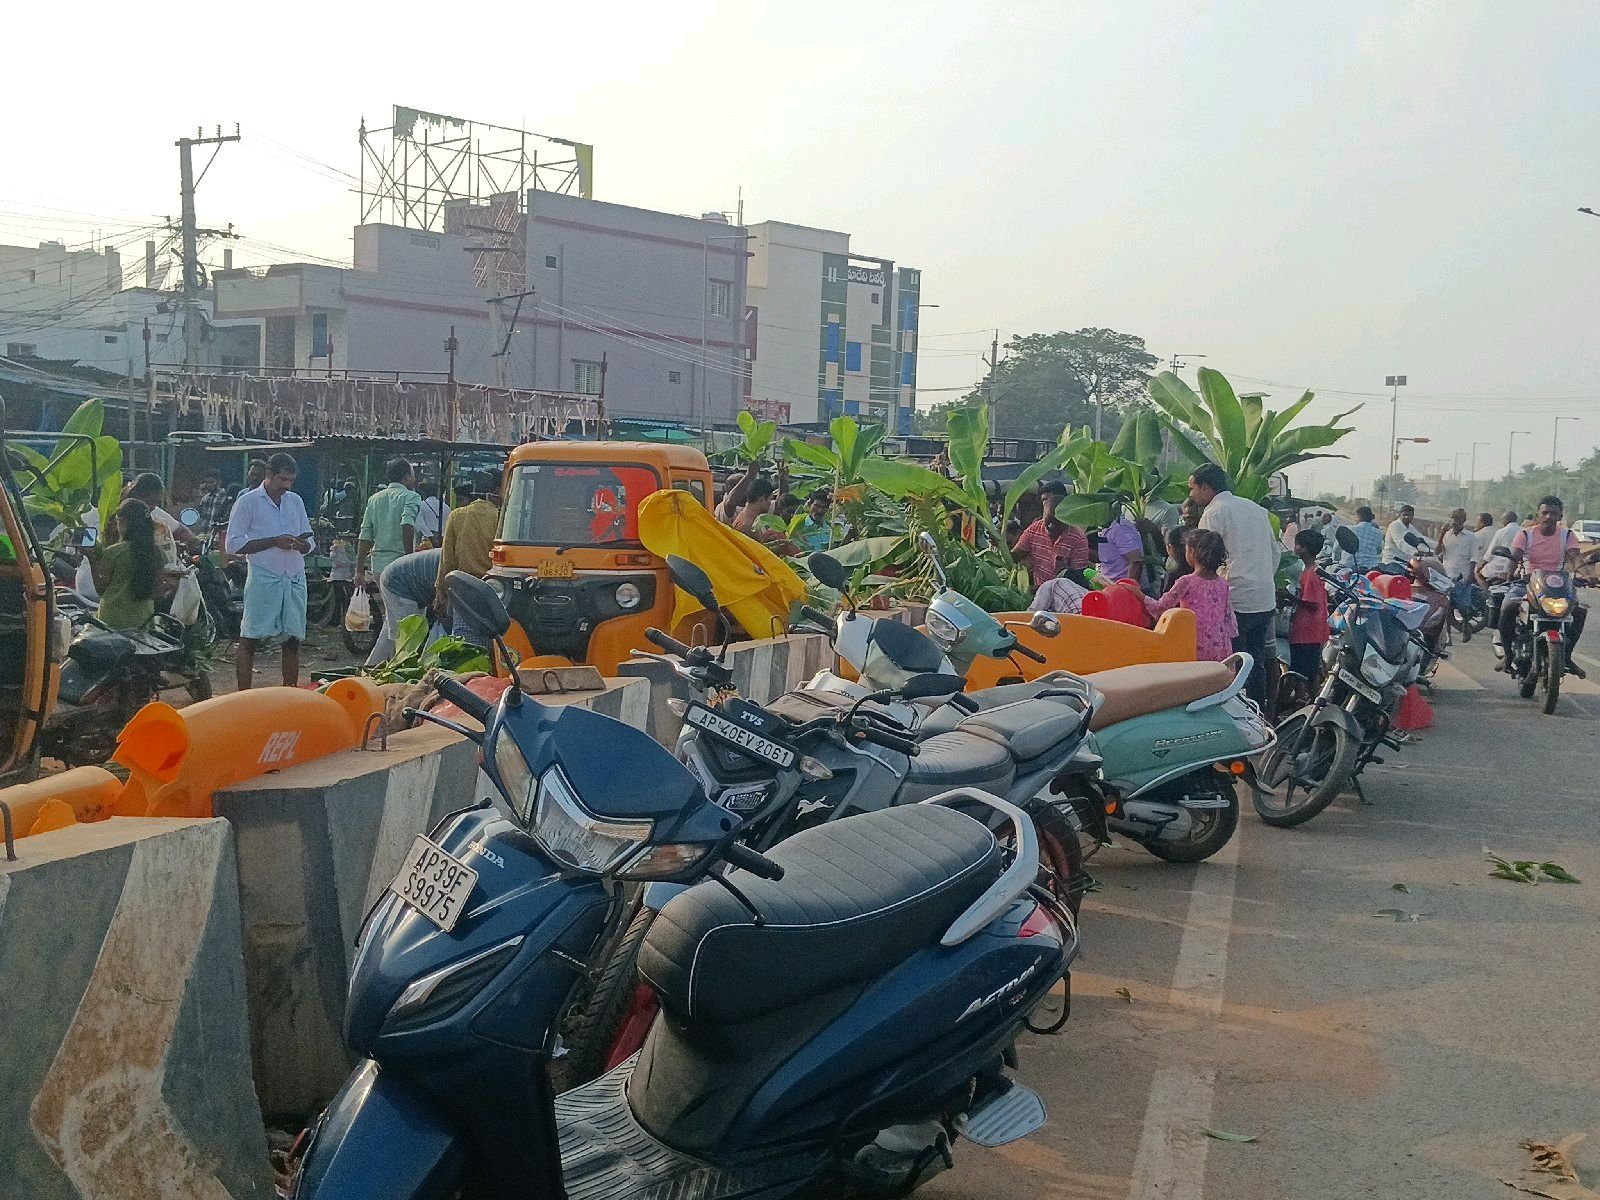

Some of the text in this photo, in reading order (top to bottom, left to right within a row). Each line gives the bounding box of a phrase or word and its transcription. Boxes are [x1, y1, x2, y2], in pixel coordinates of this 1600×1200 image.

[741, 711, 765, 726] TVS
[257, 731, 302, 763] REPL
[700, 714, 717, 728] AP
[755, 741, 789, 764] 2061
[413, 847, 468, 893] AP39F
[468, 841, 504, 868] HONDA
[404, 872, 455, 921] S9975
